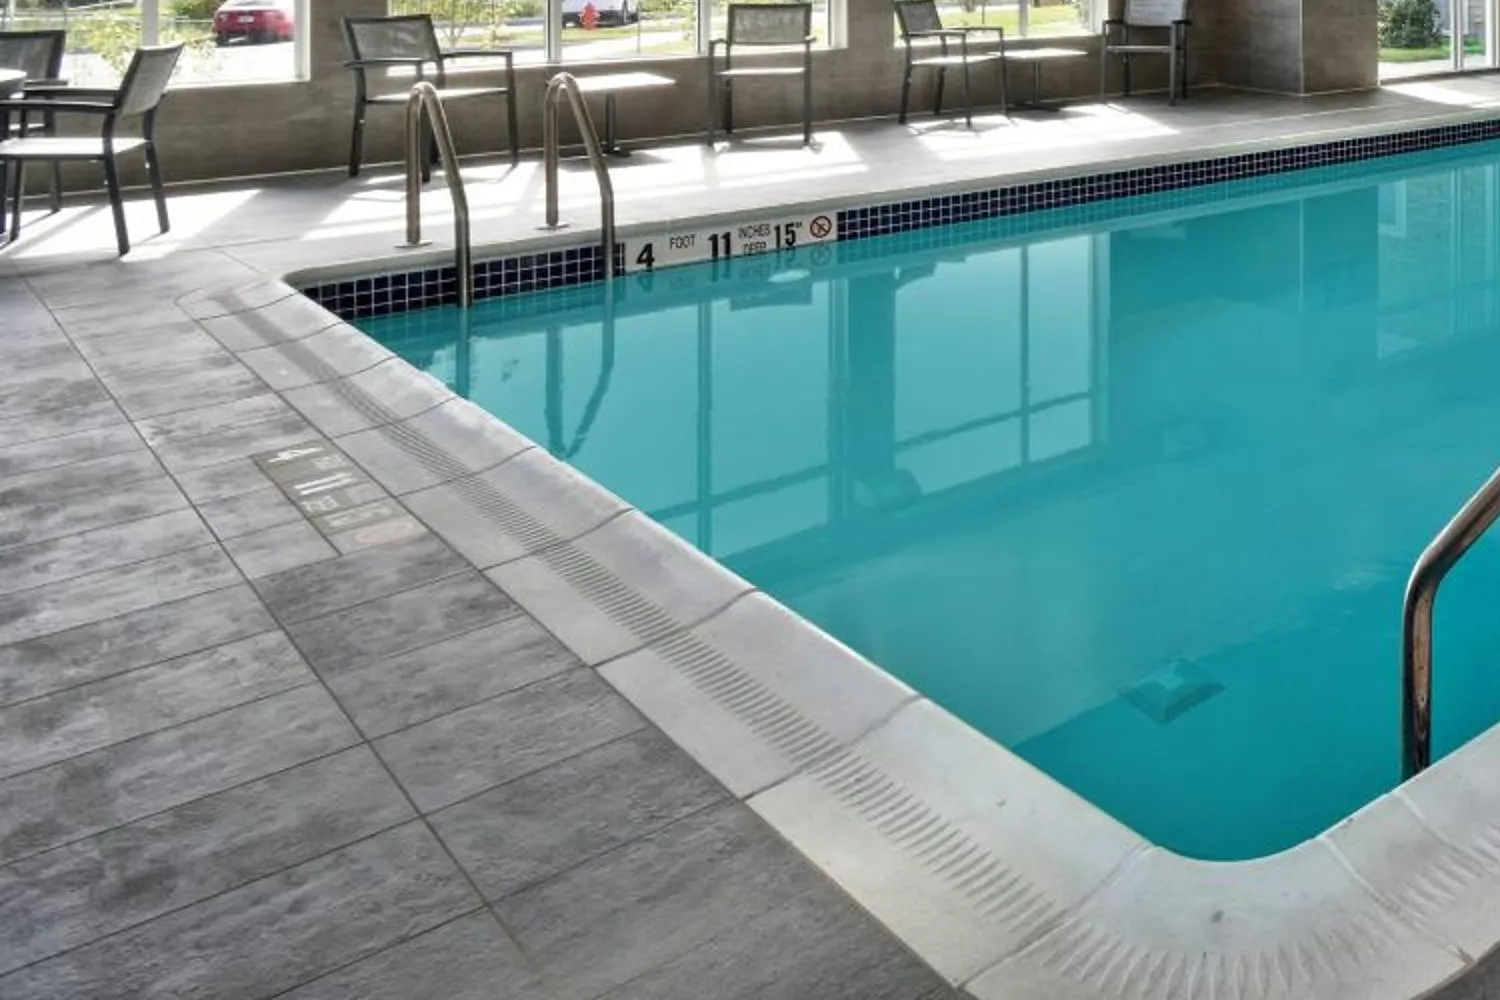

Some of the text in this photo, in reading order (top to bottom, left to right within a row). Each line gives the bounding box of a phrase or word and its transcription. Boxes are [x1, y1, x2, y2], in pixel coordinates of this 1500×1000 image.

[636, 243, 655, 272] 4
[669, 234, 696, 250] FOOT
[707, 232, 731, 261] 11
[738, 224, 771, 239] INCHES
